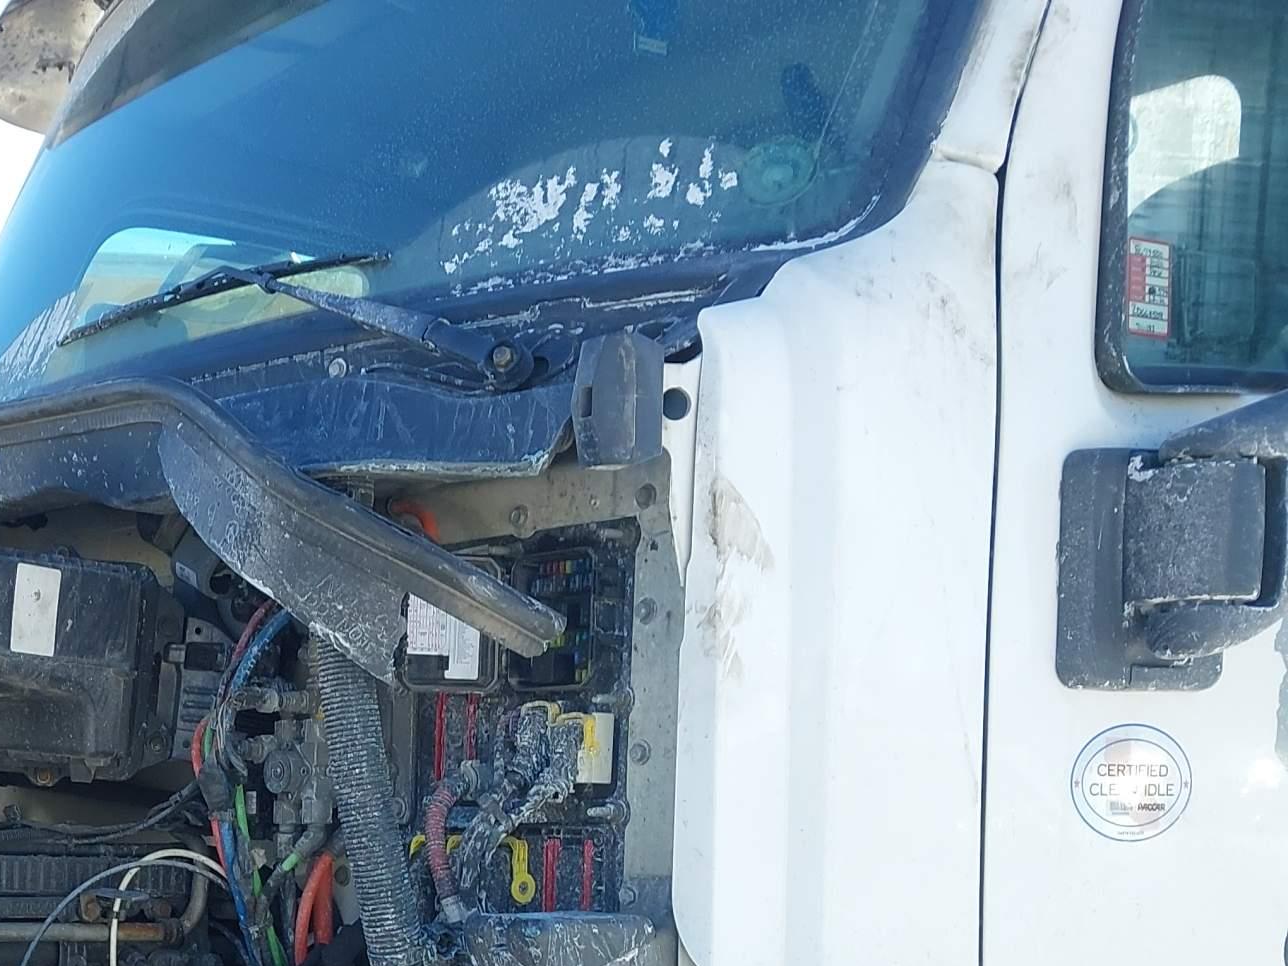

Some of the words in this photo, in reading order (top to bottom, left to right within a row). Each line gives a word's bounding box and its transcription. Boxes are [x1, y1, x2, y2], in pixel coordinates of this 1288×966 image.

[1097, 763, 1169, 777] CERTIFIED
[1089, 782, 1138, 797] CLE
[1144, 783, 1175, 797] IDLE
